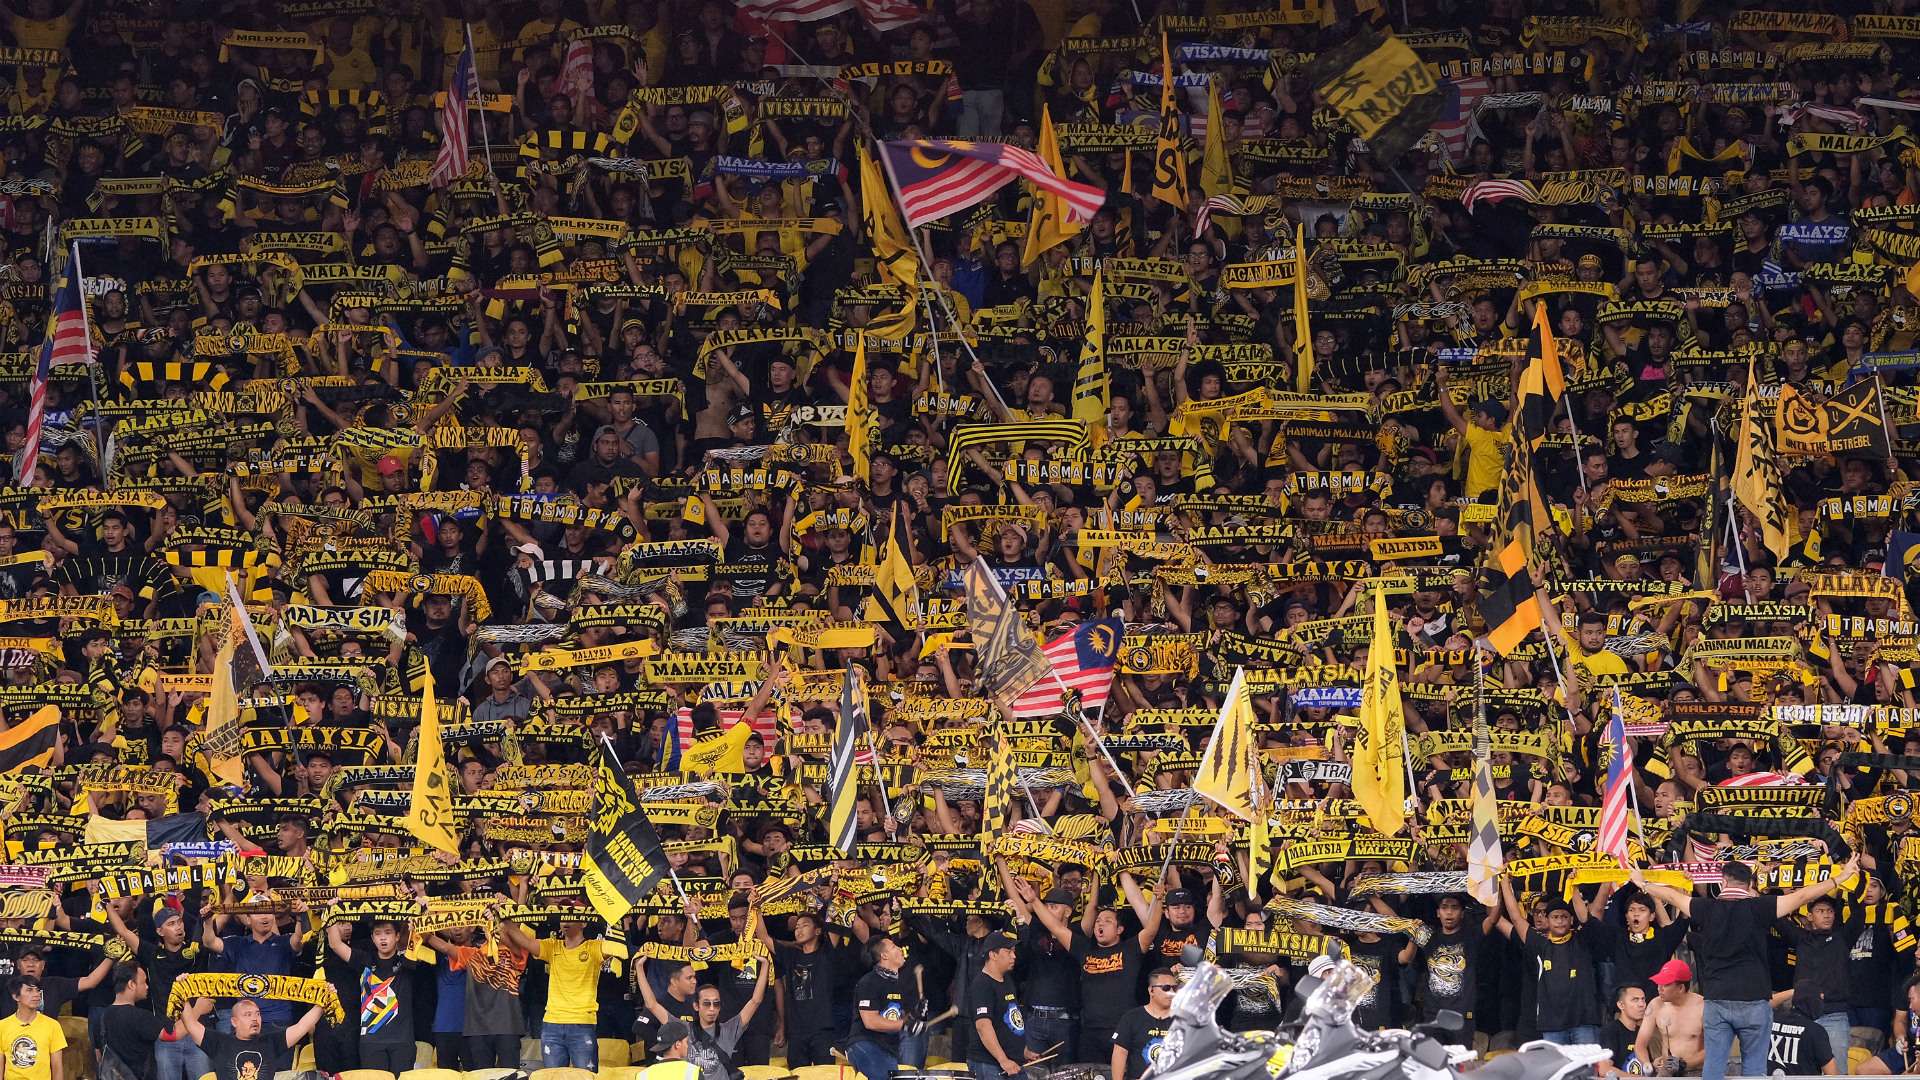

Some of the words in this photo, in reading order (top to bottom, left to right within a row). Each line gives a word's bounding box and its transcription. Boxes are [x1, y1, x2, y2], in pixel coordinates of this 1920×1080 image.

[1855, 17, 1920, 31] MALAYSI
[236, 33, 307, 45] MALAYSIA
[1068, 38, 1147, 50] MALAYSIA
[1181, 45, 1268, 60] MALAYSIA
[1067, 124, 1136, 135] MALAYSIA
[717, 156, 802, 170] MALAYSIA
[66, 217, 153, 231] MALAYSIA
[550, 219, 621, 232] MALAYSIA
[203, 251, 280, 264] MALAYSIA
[304, 266, 388, 280] MALAYSIA
[590, 284, 665, 295] MALAYSIA
[686, 290, 760, 301] MALAYSIA
[709, 327, 803, 346] MALAYSIA
[836, 335, 923, 348] TRSMALA
[438, 366, 520, 378] MALAYSIA
[586, 379, 679, 396] MAAYSIA
[1190, 396, 1246, 410] MALAYSIA
[1239, 408, 1294, 418] MALAYSIA
[118, 410, 208, 434] ALAYSIA
[1113, 437, 1200, 450] MALAYSIA
[63, 492, 141, 503] MALAYSIA
[950, 506, 1021, 518] MALAYSIA
[1190, 525, 1296, 540] MALAYSIA
[632, 540, 724, 558] MALAYSIA
[641, 566, 699, 577] MALAYSIA
[951, 569, 1044, 582] MAYSIA
[7, 597, 103, 612] MALAYSIA
[1730, 604, 1807, 617] MALAYSIA
[570, 604, 667, 621] MALAYSIA
[571, 648, 613, 660] MALAYSIA
[272, 669, 351, 681] ALAYSIA
[652, 662, 747, 677] MALAYSIA
[1675, 704, 1756, 714] MALAYSIA
[1778, 705, 1816, 721] EKOR
[1135, 715, 1219, 725] MALAYA
[1671, 720, 1780, 736] MALAYSIA
[1103, 734, 1185, 749] ALAYSIA
[1440, 733, 1542, 748] MAAYSIA
[345, 767, 416, 781] MALAY
[1168, 819, 1207, 828] MAAYSIA
[1288, 844, 1343, 859] MALAYSIA
[1354, 840, 1411, 850] HARIMAU
[25, 842, 130, 863] MALAYSIA
[616, 829, 655, 878] HARIMAU
[1354, 848, 1408, 858] MALAYA
[603, 838, 643, 889] MALAYA
[1664, 862, 1724, 872] MALAYS
[329, 900, 422, 915] ALAYSIA
[1233, 930, 1320, 952] MALAYSIA
[1768, 1034, 1800, 1066] XII
